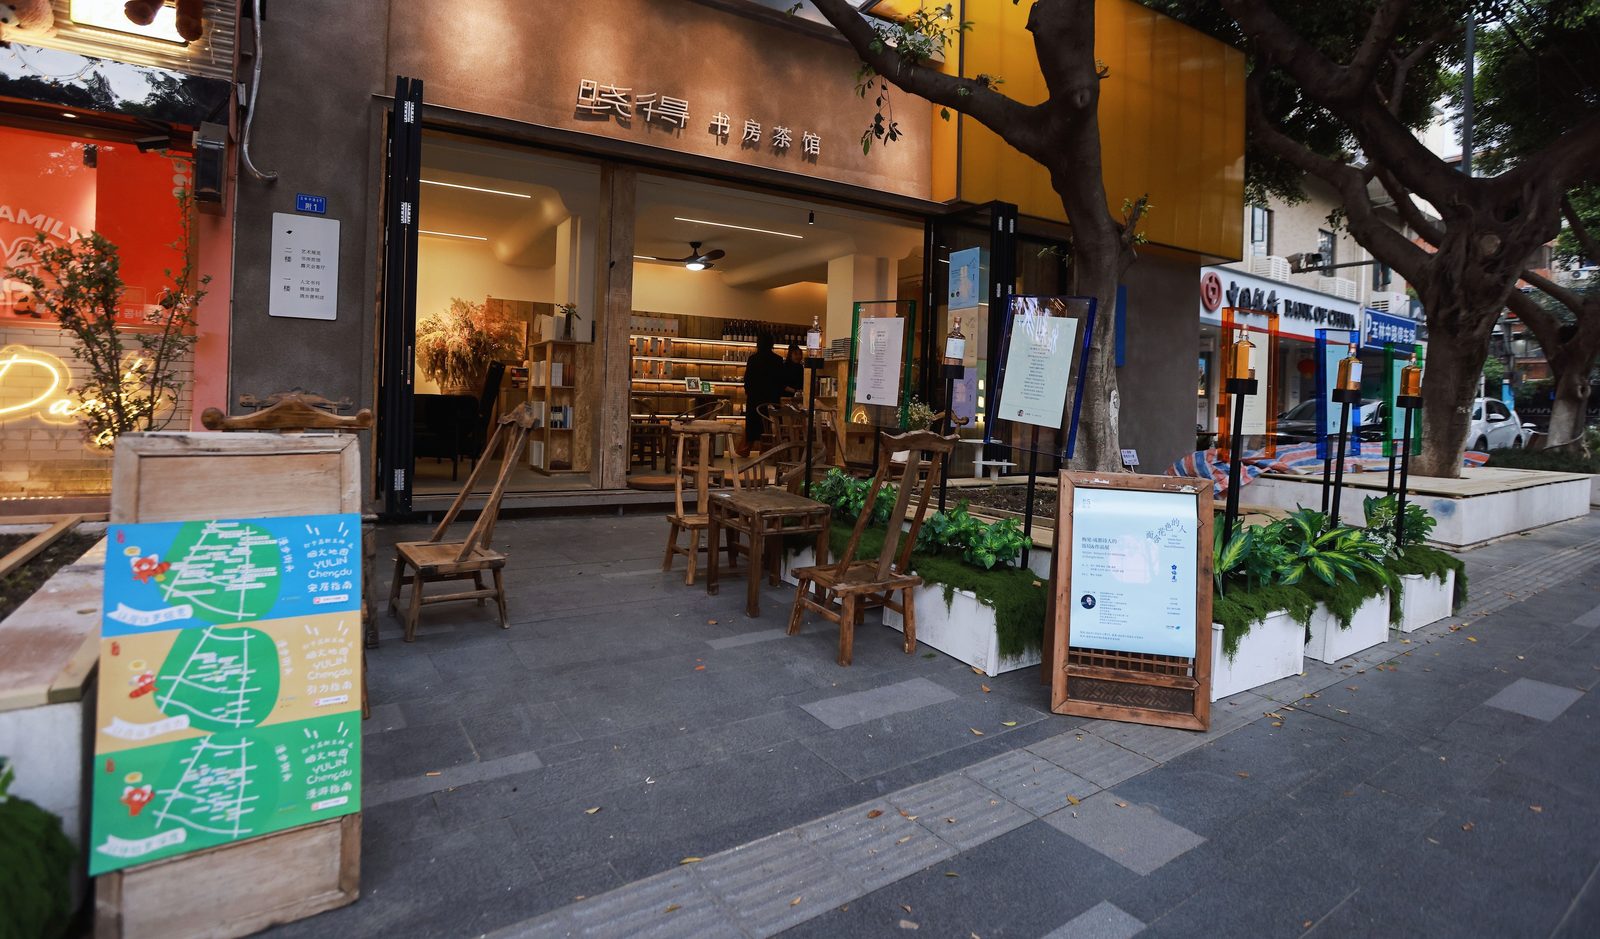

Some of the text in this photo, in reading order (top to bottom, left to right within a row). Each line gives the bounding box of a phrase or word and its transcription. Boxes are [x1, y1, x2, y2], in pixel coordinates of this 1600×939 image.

[710, 111, 821, 155] 书房茶馆
[1284, 299, 1314, 321] BANK
[1314, 306, 1328, 324] OF
[1328, 309, 1356, 330] CHINA
[308, 568, 352, 578] Chengdu
[313, 556, 348, 569] YULIN
